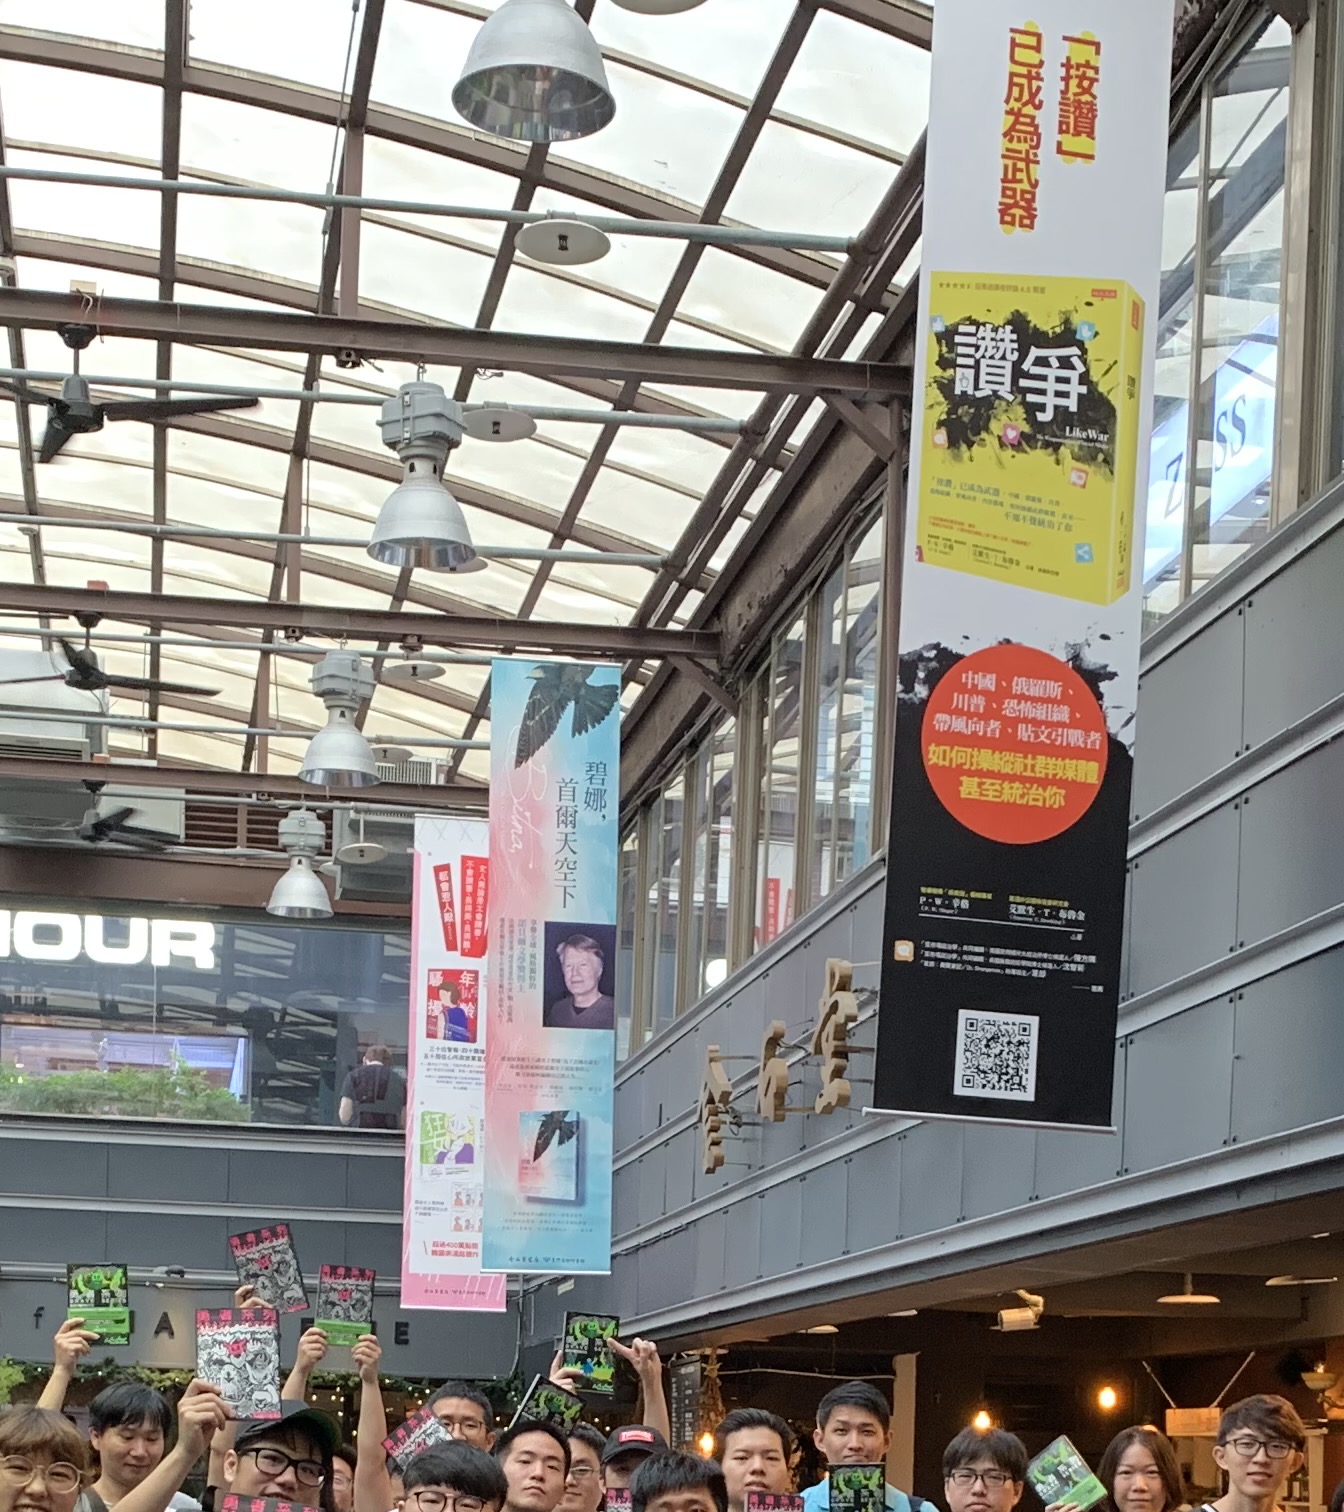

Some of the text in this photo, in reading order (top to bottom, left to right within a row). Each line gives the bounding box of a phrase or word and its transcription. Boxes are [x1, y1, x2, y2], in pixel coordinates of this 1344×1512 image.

[998, 28, 1044, 230] 已成為武器
[954, 324, 1088, 422] 讚爭
[1066, 427, 1109, 442] LikeWar
[962, 671, 1073, 698] 中國、俄羅斯、
[951, 693, 1081, 724] 川普、恐怖組織、
[933, 714, 1102, 750] 帶風向者、貼文引戰者
[928, 744, 1098, 783] 如何操縱社群媒體
[959, 776, 1066, 808] 甚至統治你
[554, 778, 578, 909] 首爾天空下
